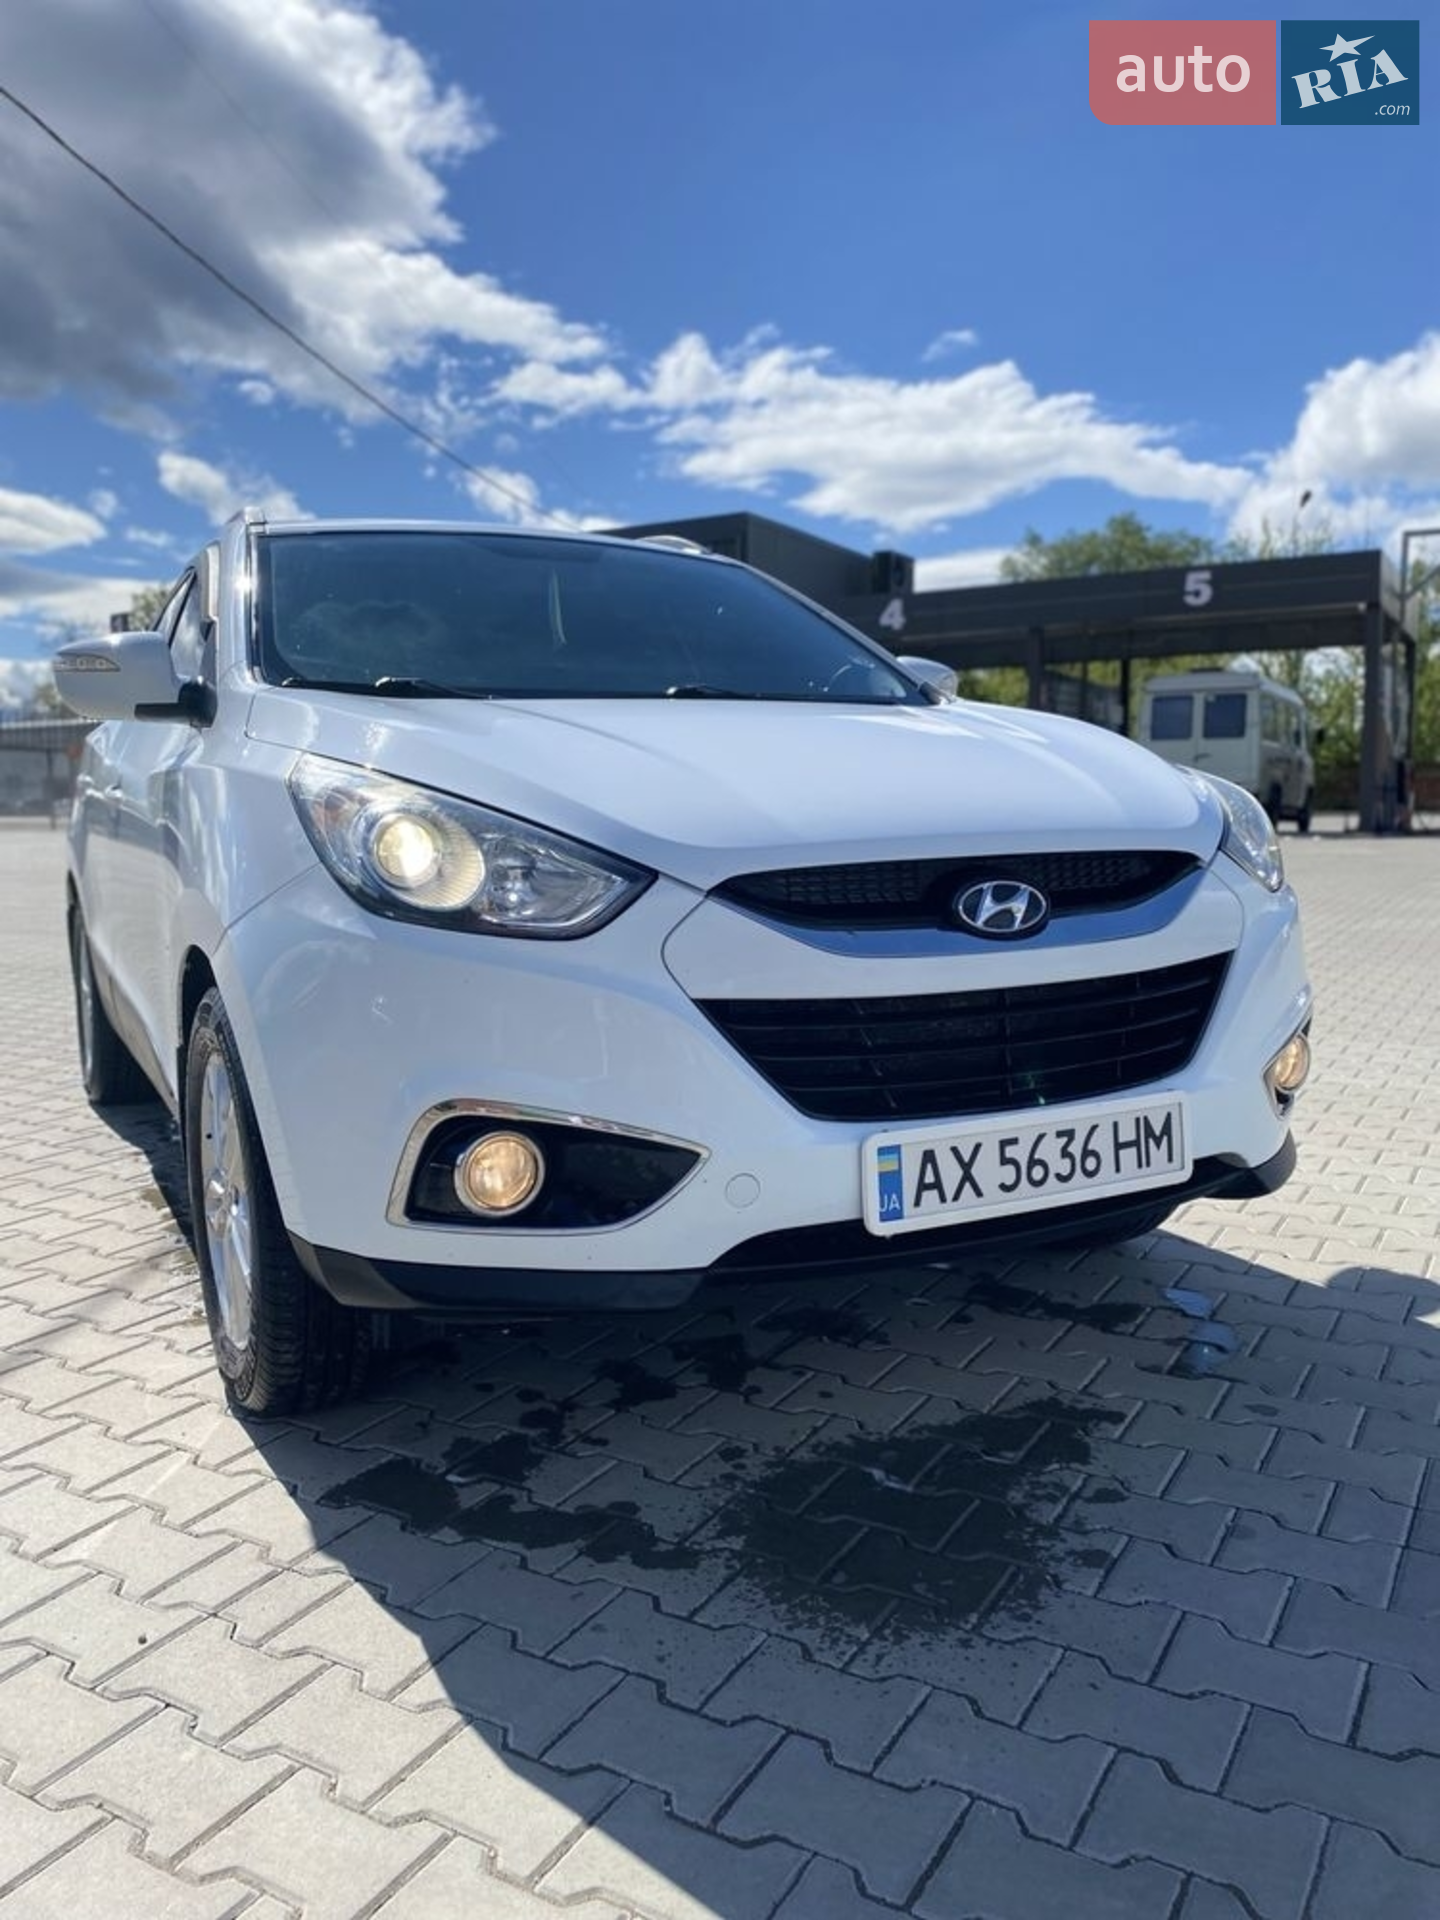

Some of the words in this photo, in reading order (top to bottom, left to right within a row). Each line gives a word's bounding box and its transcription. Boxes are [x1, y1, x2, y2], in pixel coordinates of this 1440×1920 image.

[1183, 571, 1213, 606] 5
[879, 599, 906, 630] 4
[913, 1142, 984, 1208] AX
[998, 1124, 1102, 1193] 5636
[1113, 1111, 1174, 1174] HM
